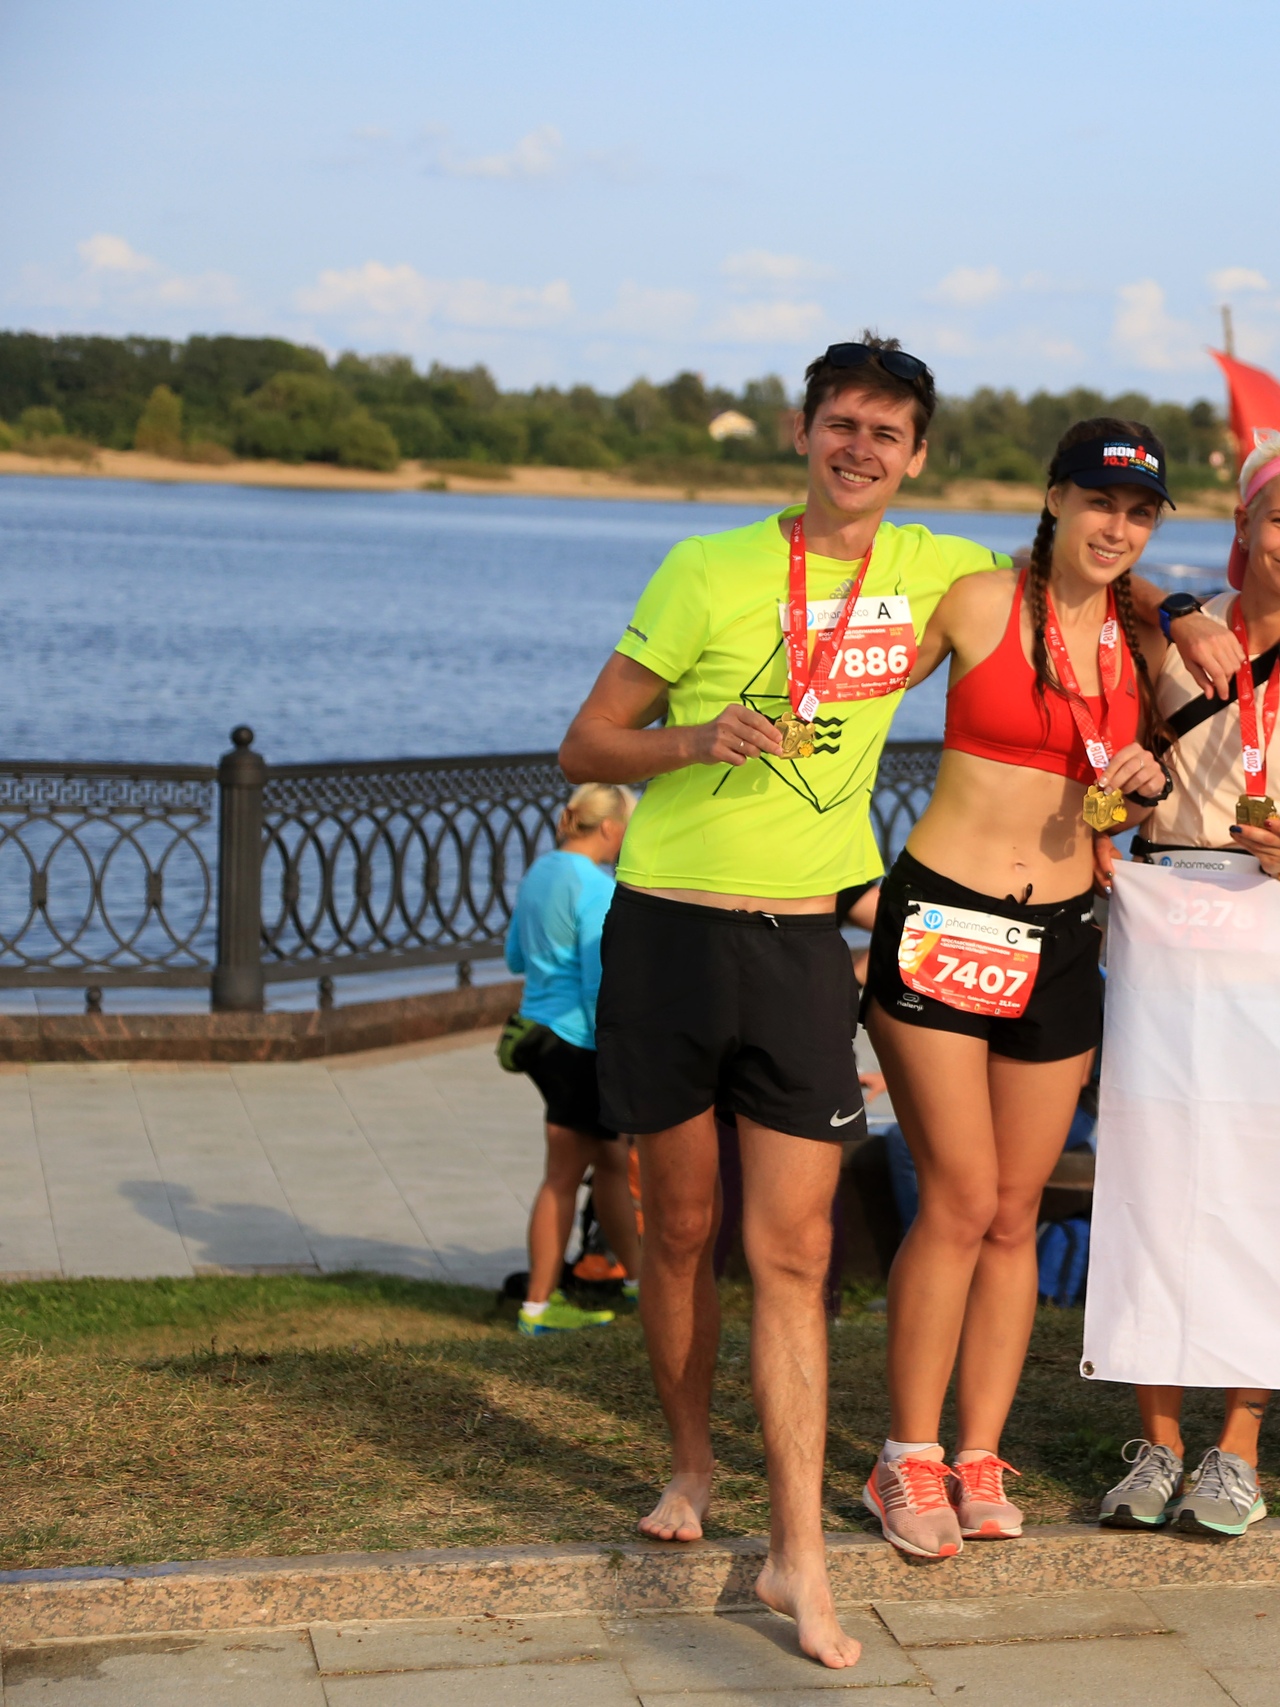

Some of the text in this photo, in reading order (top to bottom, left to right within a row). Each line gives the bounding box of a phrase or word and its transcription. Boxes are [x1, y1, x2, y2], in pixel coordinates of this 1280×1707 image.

[1103, 456, 1129, 467] 70.3
[817, 609, 869, 622] phareco
[877, 601, 891, 619] A
[828, 644, 909, 680] 7886
[801, 695, 817, 717] 2018
[1090, 745, 1108, 767] 2018
[1246, 751, 1259, 770] 2018
[945, 917, 999, 936] pharmeco
[1006, 927, 1021, 944] C
[932, 954, 1028, 997] 7407
